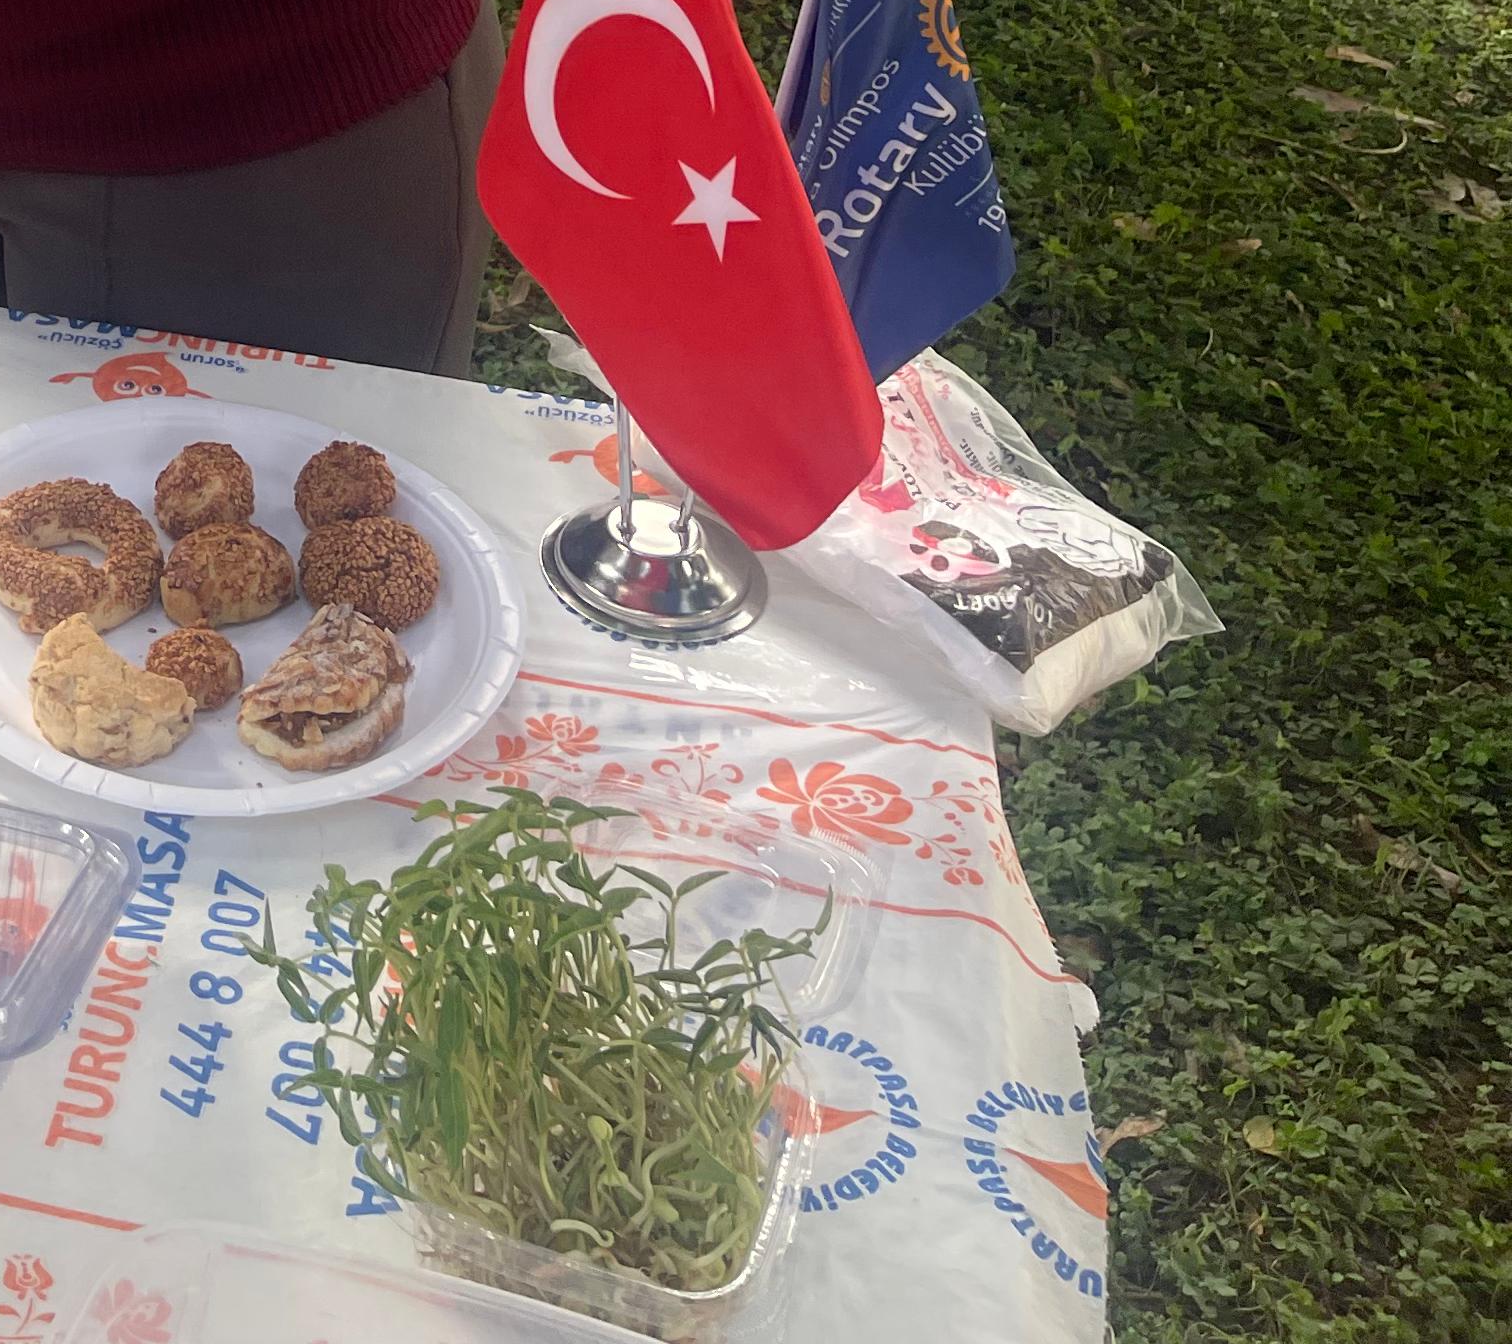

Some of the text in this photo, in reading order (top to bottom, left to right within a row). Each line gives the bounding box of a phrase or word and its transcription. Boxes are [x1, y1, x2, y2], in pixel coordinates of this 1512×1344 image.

[814, 81, 958, 259] Rotary
[44, 811, 195, 1150] TURUNÇ MASA
[159, 867, 267, 1119] 444 8 007
[798, 1023, 922, 1130] RATPAŞA
[963, 1136, 1105, 1300] URATPAŞA
